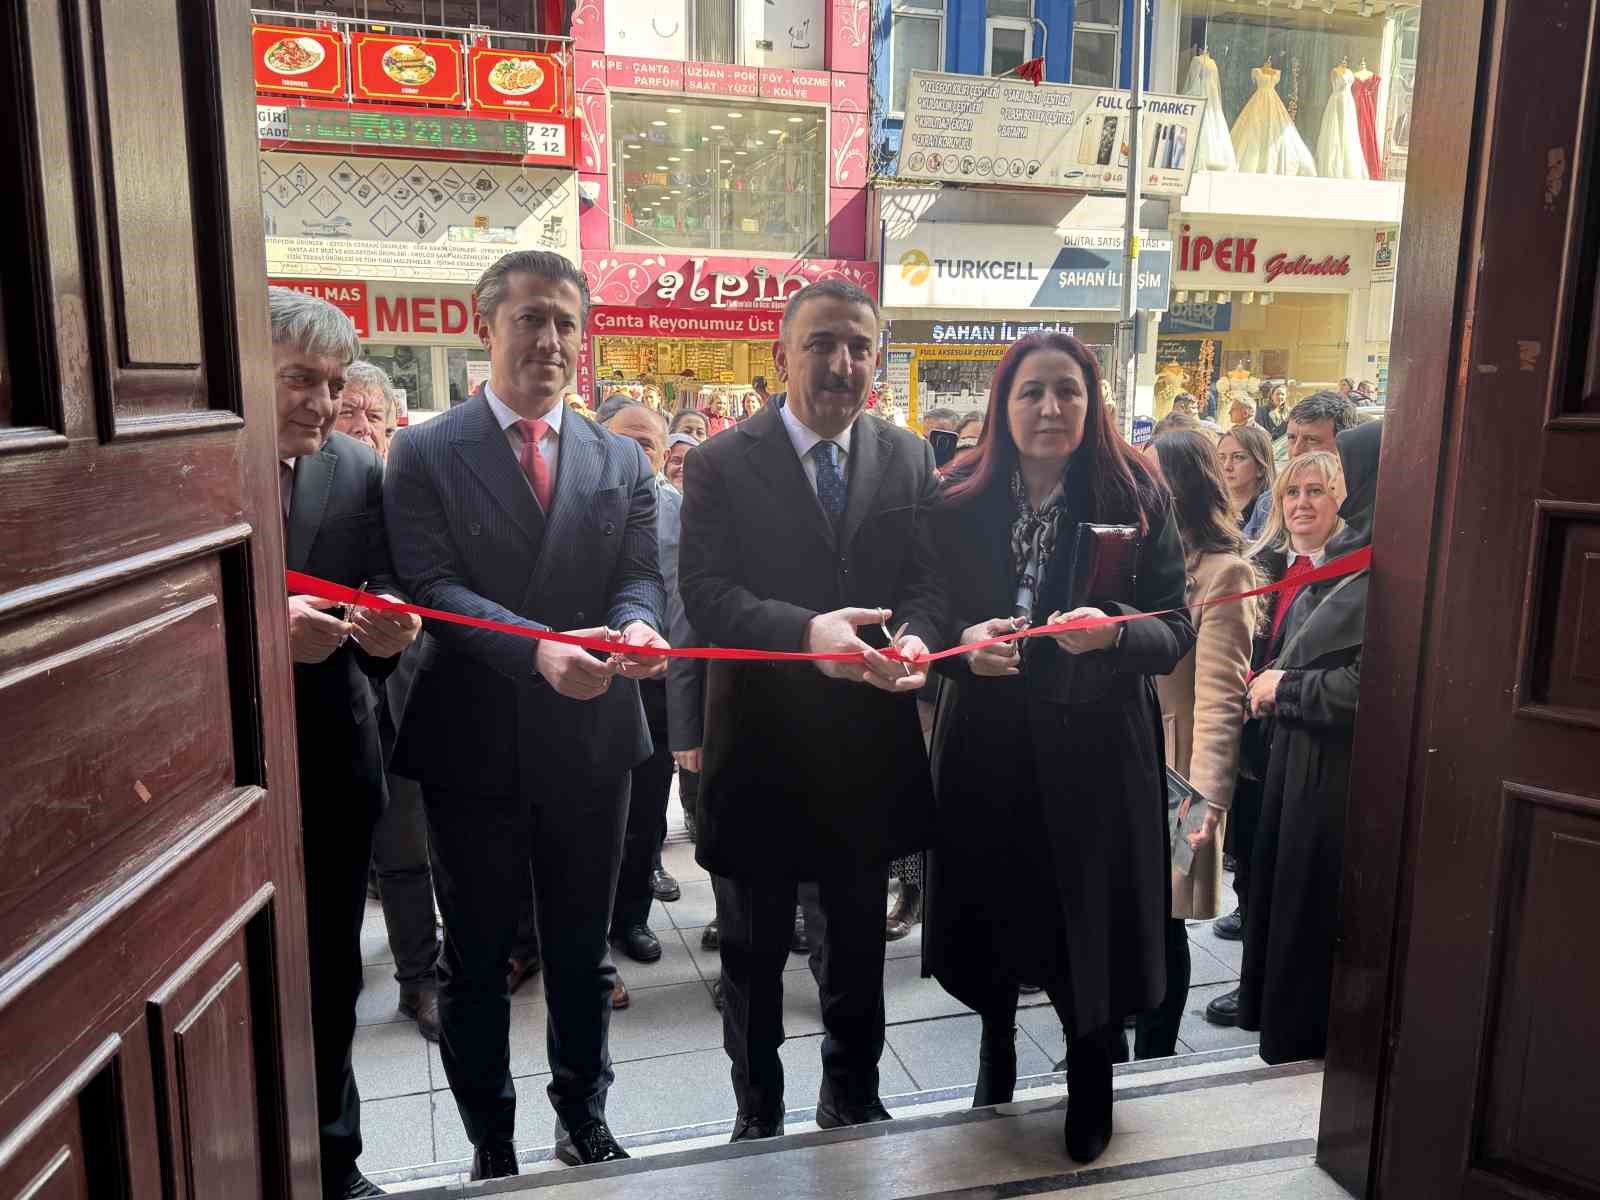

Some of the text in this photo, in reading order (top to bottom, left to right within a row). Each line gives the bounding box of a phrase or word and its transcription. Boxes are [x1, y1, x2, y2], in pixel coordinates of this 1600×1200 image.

[632, 62, 670, 74] ÇANTA
[734, 71, 784, 84] PORFÖY
[792, 75, 846, 88] KOZMEİK
[689, 80, 718, 90] SAAT
[773, 87, 808, 98] KOLYE
[258, 109, 287, 122] GİRİ
[1096, 96, 1123, 110] FULL
[1149, 101, 1196, 116] MARKET
[260, 127, 288, 137] CADD
[541, 127, 558, 137] 27
[542, 143, 559, 152] 12
[1064, 235, 1094, 247] DİJİTAL
[1097, 238, 1121, 249] SATIŞ
[1180, 225, 1258, 273] İPEK
[934, 258, 1039, 280] TURKCELL
[1265, 252, 1350, 283] Gelinlik
[1059, 270, 1161, 290] ŞAHAN İLŞİM
[292, 286, 360, 301] ELMAS
[594, 313, 644, 334] Çanta
[649, 314, 744, 335] Reyonumuz
[748, 315, 775, 333] Üst
[932, 324, 995, 343] ŞAHAN
